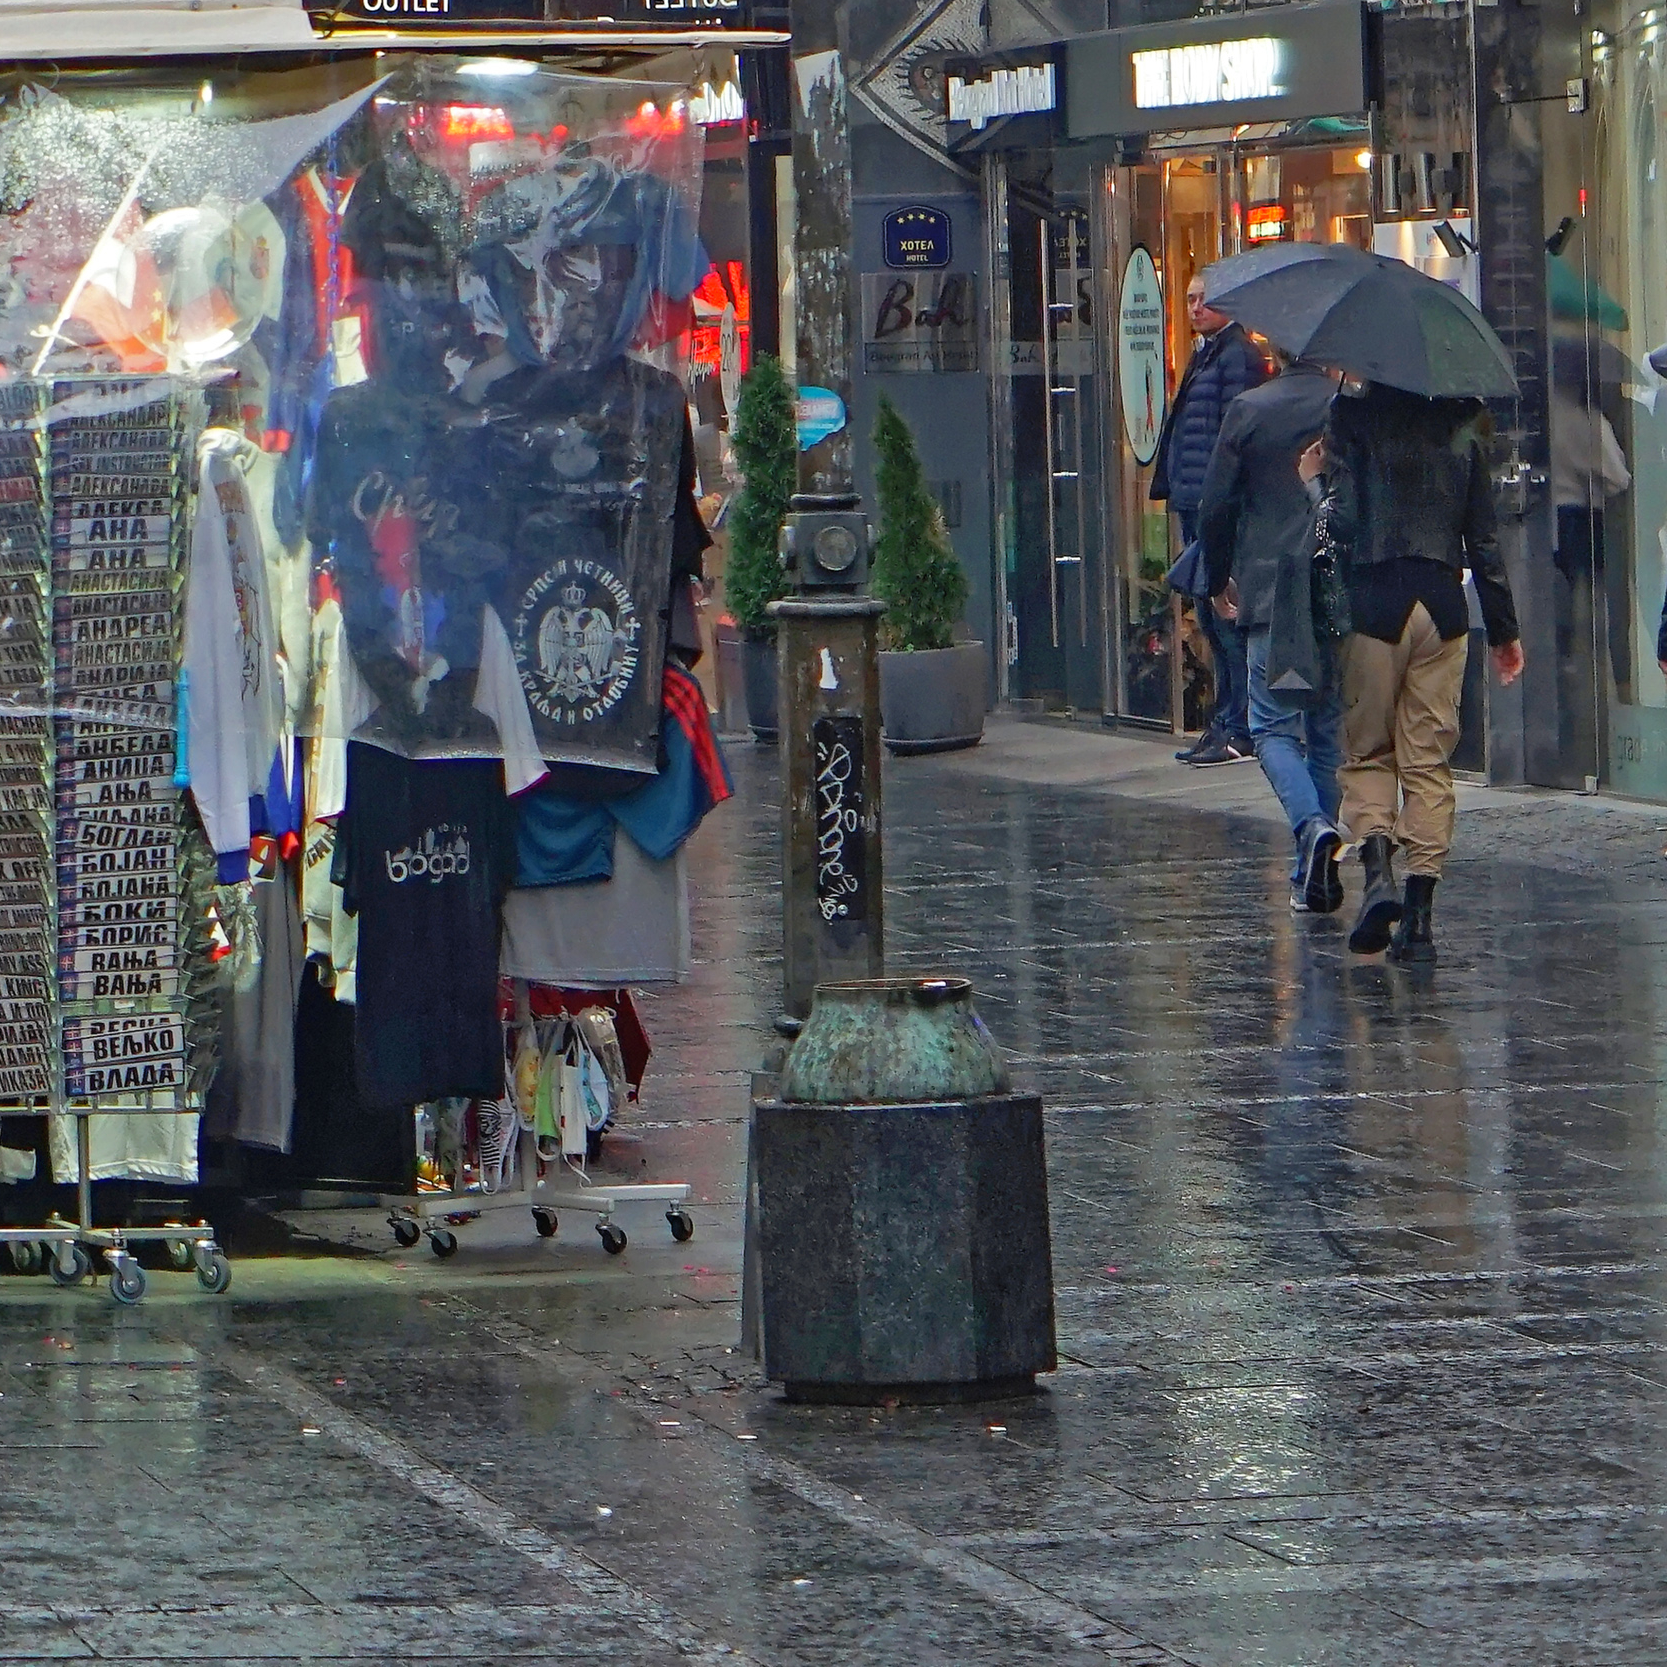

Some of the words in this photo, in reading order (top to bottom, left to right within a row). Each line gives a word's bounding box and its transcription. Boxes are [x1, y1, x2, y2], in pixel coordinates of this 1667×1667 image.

[1132, 50, 1169, 109] THE
[900, 240, 934, 251] ХОТЕЛ
[906, 254, 929, 263] HOTEL
[88, 518, 149, 541] АНА
[88, 548, 147, 570] АНА
[70, 570, 169, 593] АНАСТАСИЈА
[72, 593, 168, 615] АНАСТАСИЈА
[77, 613, 167, 641] АНДРЕА
[75, 639, 171, 666] АНАСТАСИЈА
[98, 780, 153, 803] АЊА
[82, 847, 167, 872] БОЈАН
[82, 875, 169, 897] БОЈАНА
[84, 900, 167, 922] БОКИ
[86, 923, 168, 945] БОРИС
[91, 949, 158, 971] ВАЊА
[5, 976, 44, 998] KING
[94, 972, 162, 996] ВАЊА
[93, 1029, 174, 1061] ВЕЉКО
[89, 1062, 175, 1091] ВЛАДА
